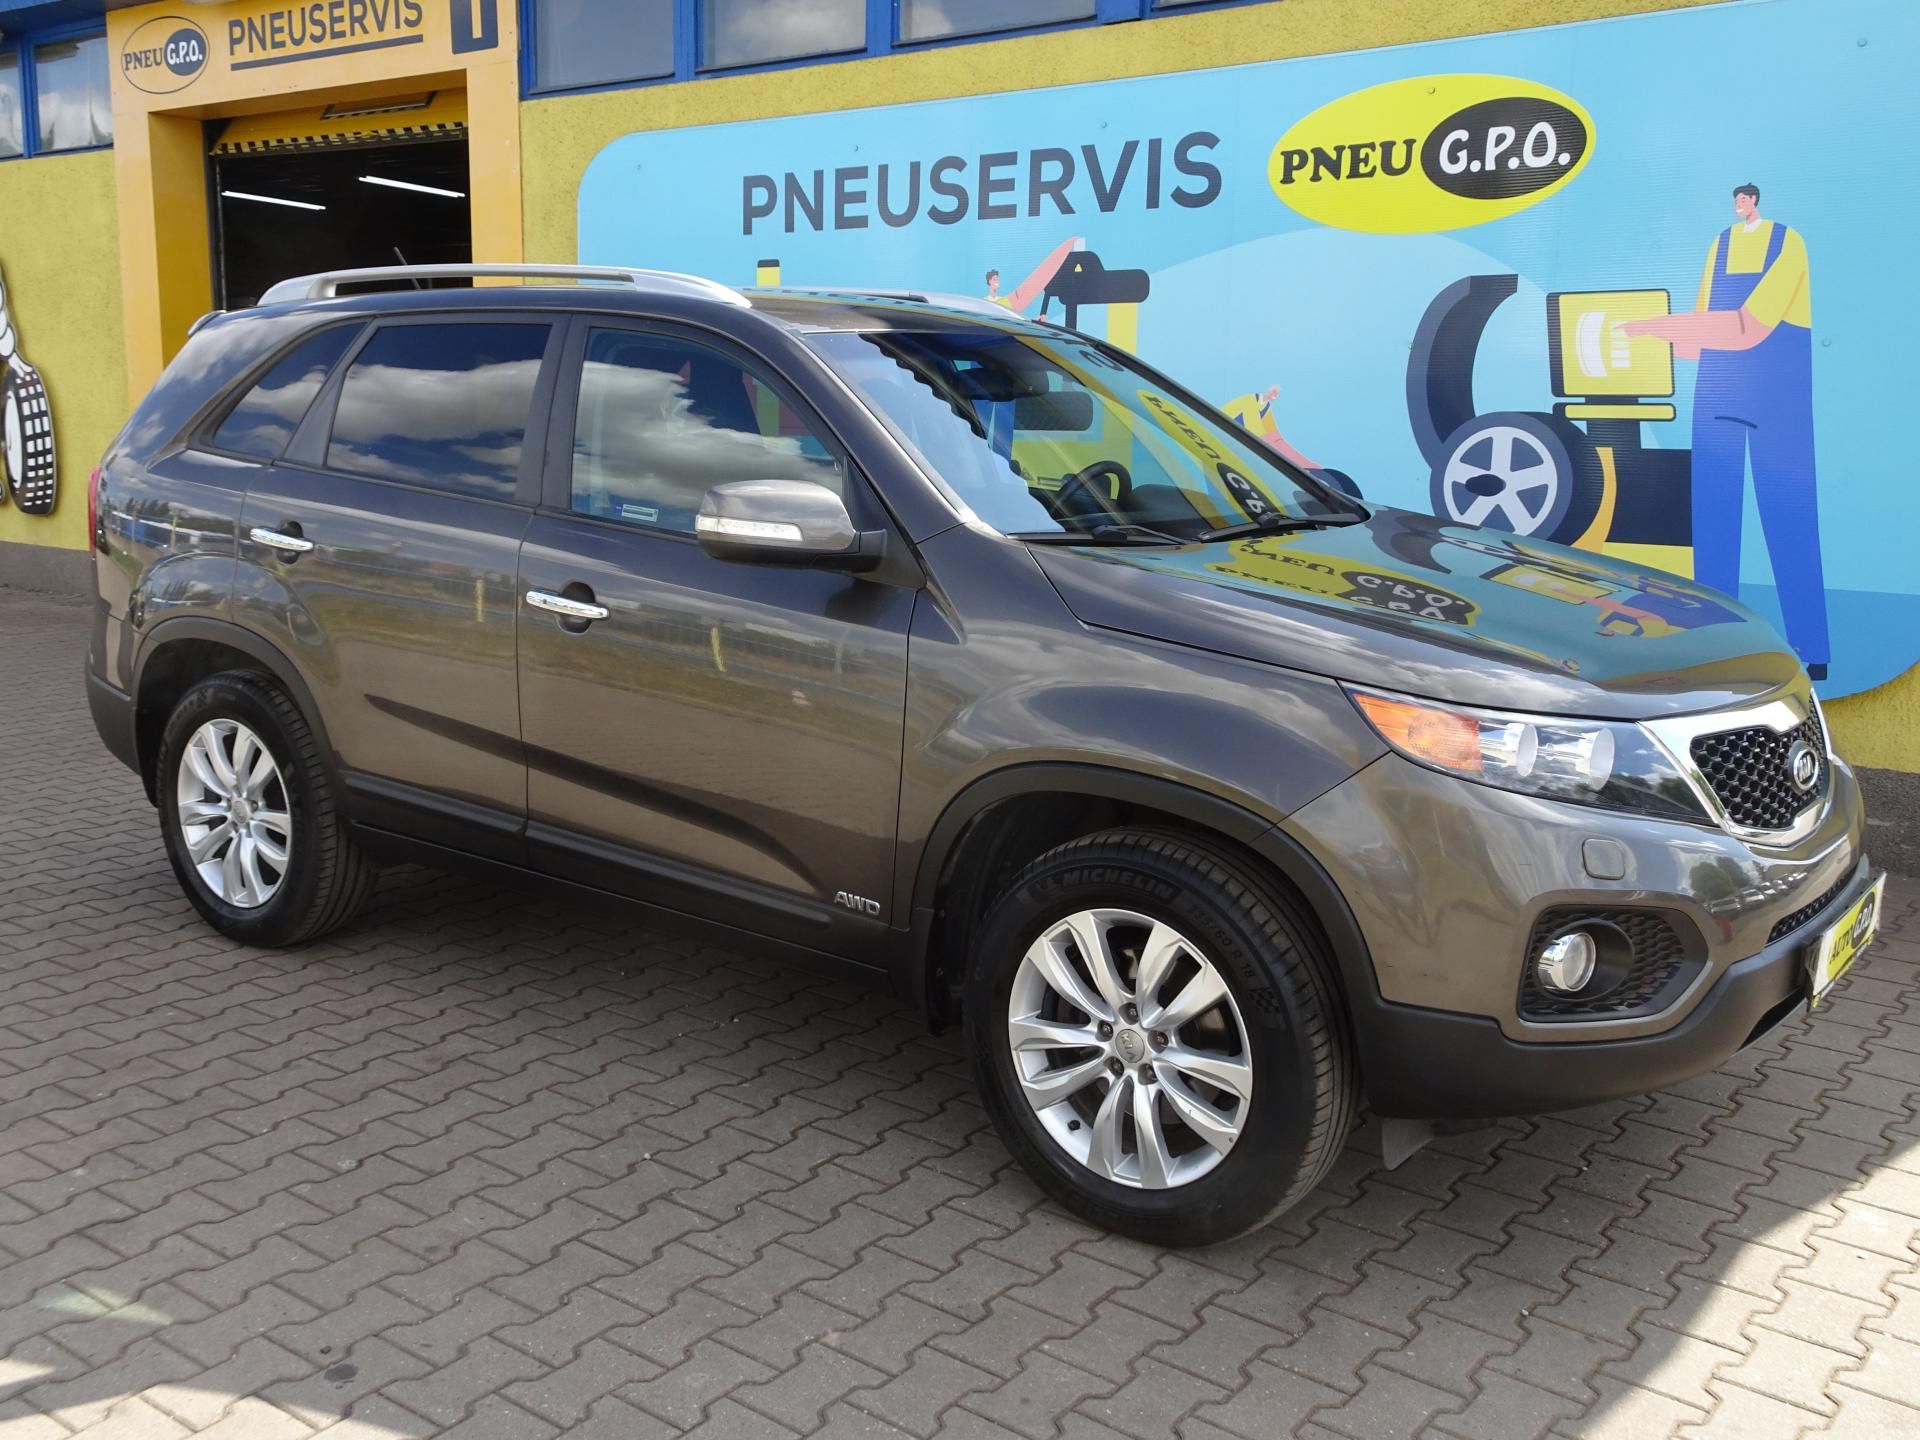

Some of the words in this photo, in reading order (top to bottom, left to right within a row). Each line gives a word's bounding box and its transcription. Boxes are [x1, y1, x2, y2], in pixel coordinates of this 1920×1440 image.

[228, 0, 424, 56] PNEUSERVIS
[123, 47, 163, 71] PNEU
[167, 40, 203, 65] G.P.O.
[1280, 138, 1417, 185] PNEU
[1439, 121, 1571, 174] G.P.O.
[743, 131, 1223, 235] PNEUSERVIS
[834, 890, 880, 916] AWD
[1063, 869, 1175, 899] MICHELIN
